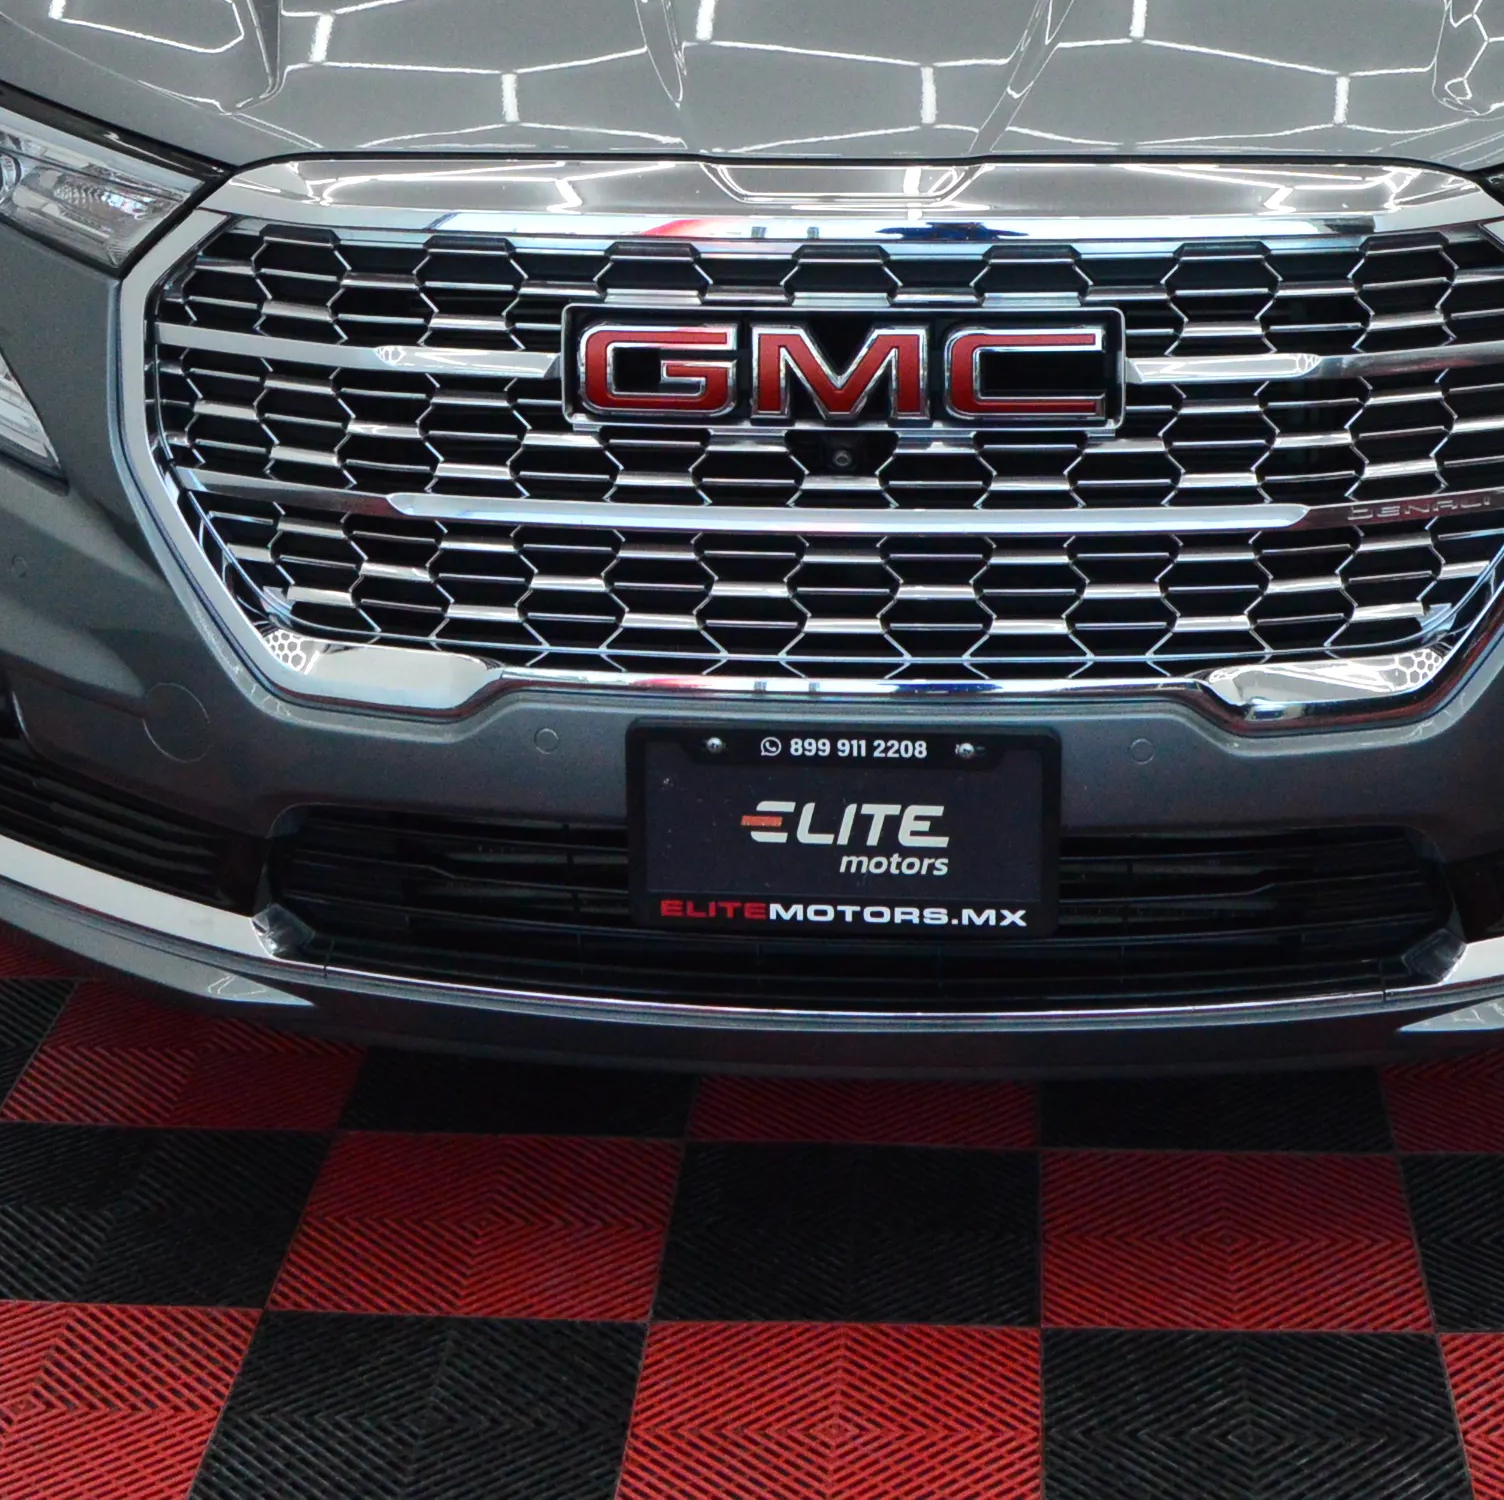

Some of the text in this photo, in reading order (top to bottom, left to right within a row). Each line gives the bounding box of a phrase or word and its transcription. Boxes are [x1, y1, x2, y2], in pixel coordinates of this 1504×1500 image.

[579, 323, 1107, 422] GMC
[789, 738, 928, 759] 899 911 2208
[740, 801, 950, 848] ELITE
[839, 853, 949, 876] motors
[659, 898, 1028, 928] ELITEMOTORS.MX
